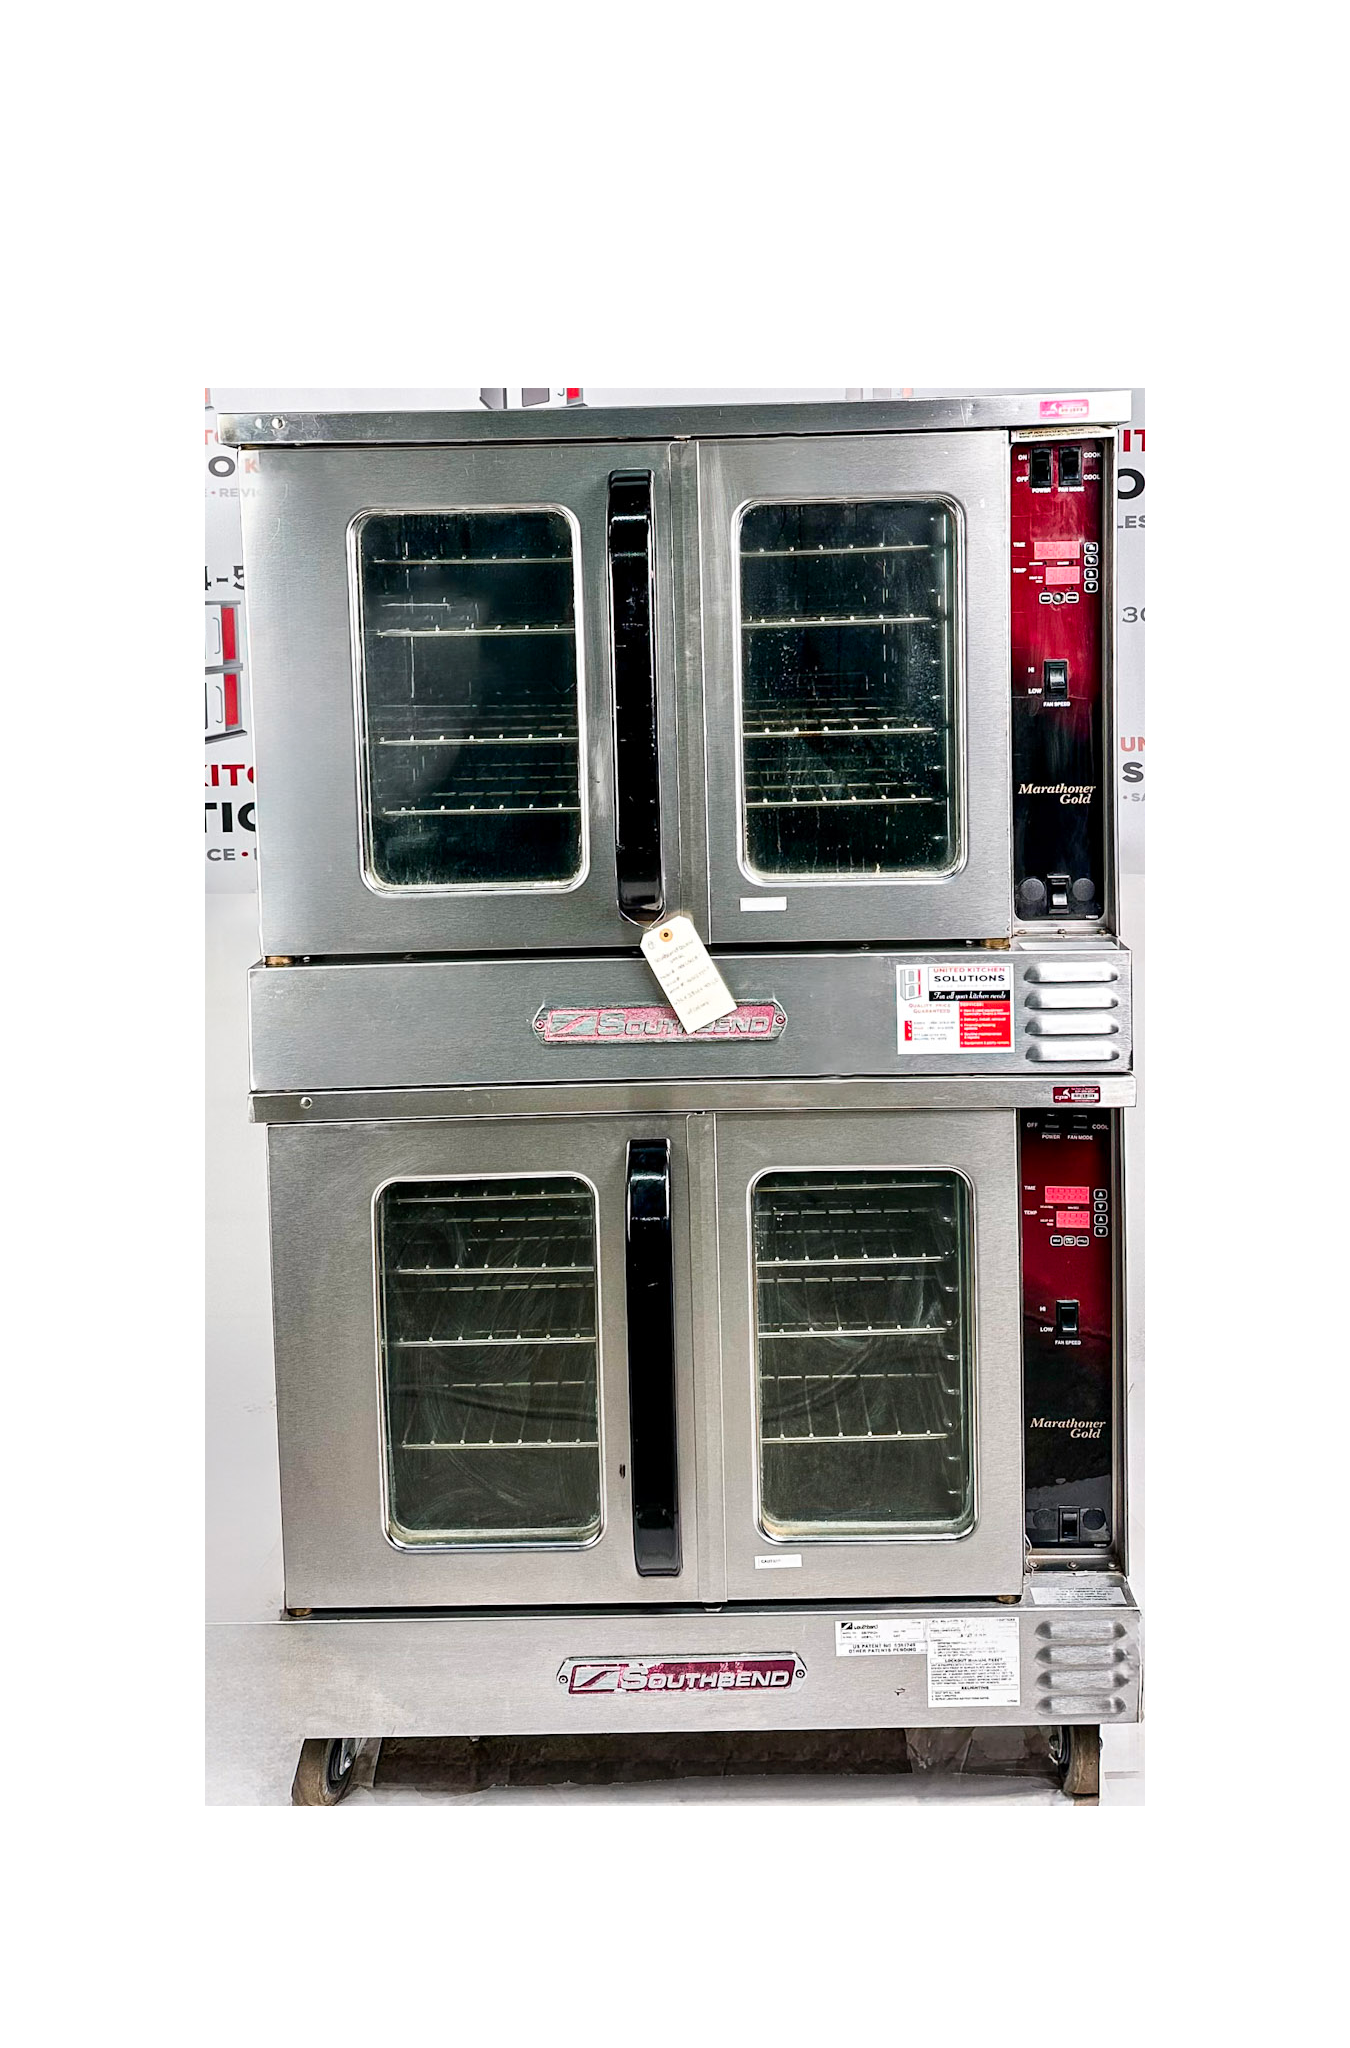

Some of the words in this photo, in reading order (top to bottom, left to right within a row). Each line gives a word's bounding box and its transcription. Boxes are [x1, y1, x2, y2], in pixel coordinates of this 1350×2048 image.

[1016, 475, 1029, 483] OFF
[1018, 783, 1096, 795] Marathoner
[1059, 794, 1091, 805] Gold
[969, 991, 989, 999] kitchen
[990, 990, 1006, 999] needs
[597, 1012, 769, 1036] SOUTEND
[1030, 1418, 1106, 1429] Marathoner
[1070, 1428, 1101, 1439] Gold
